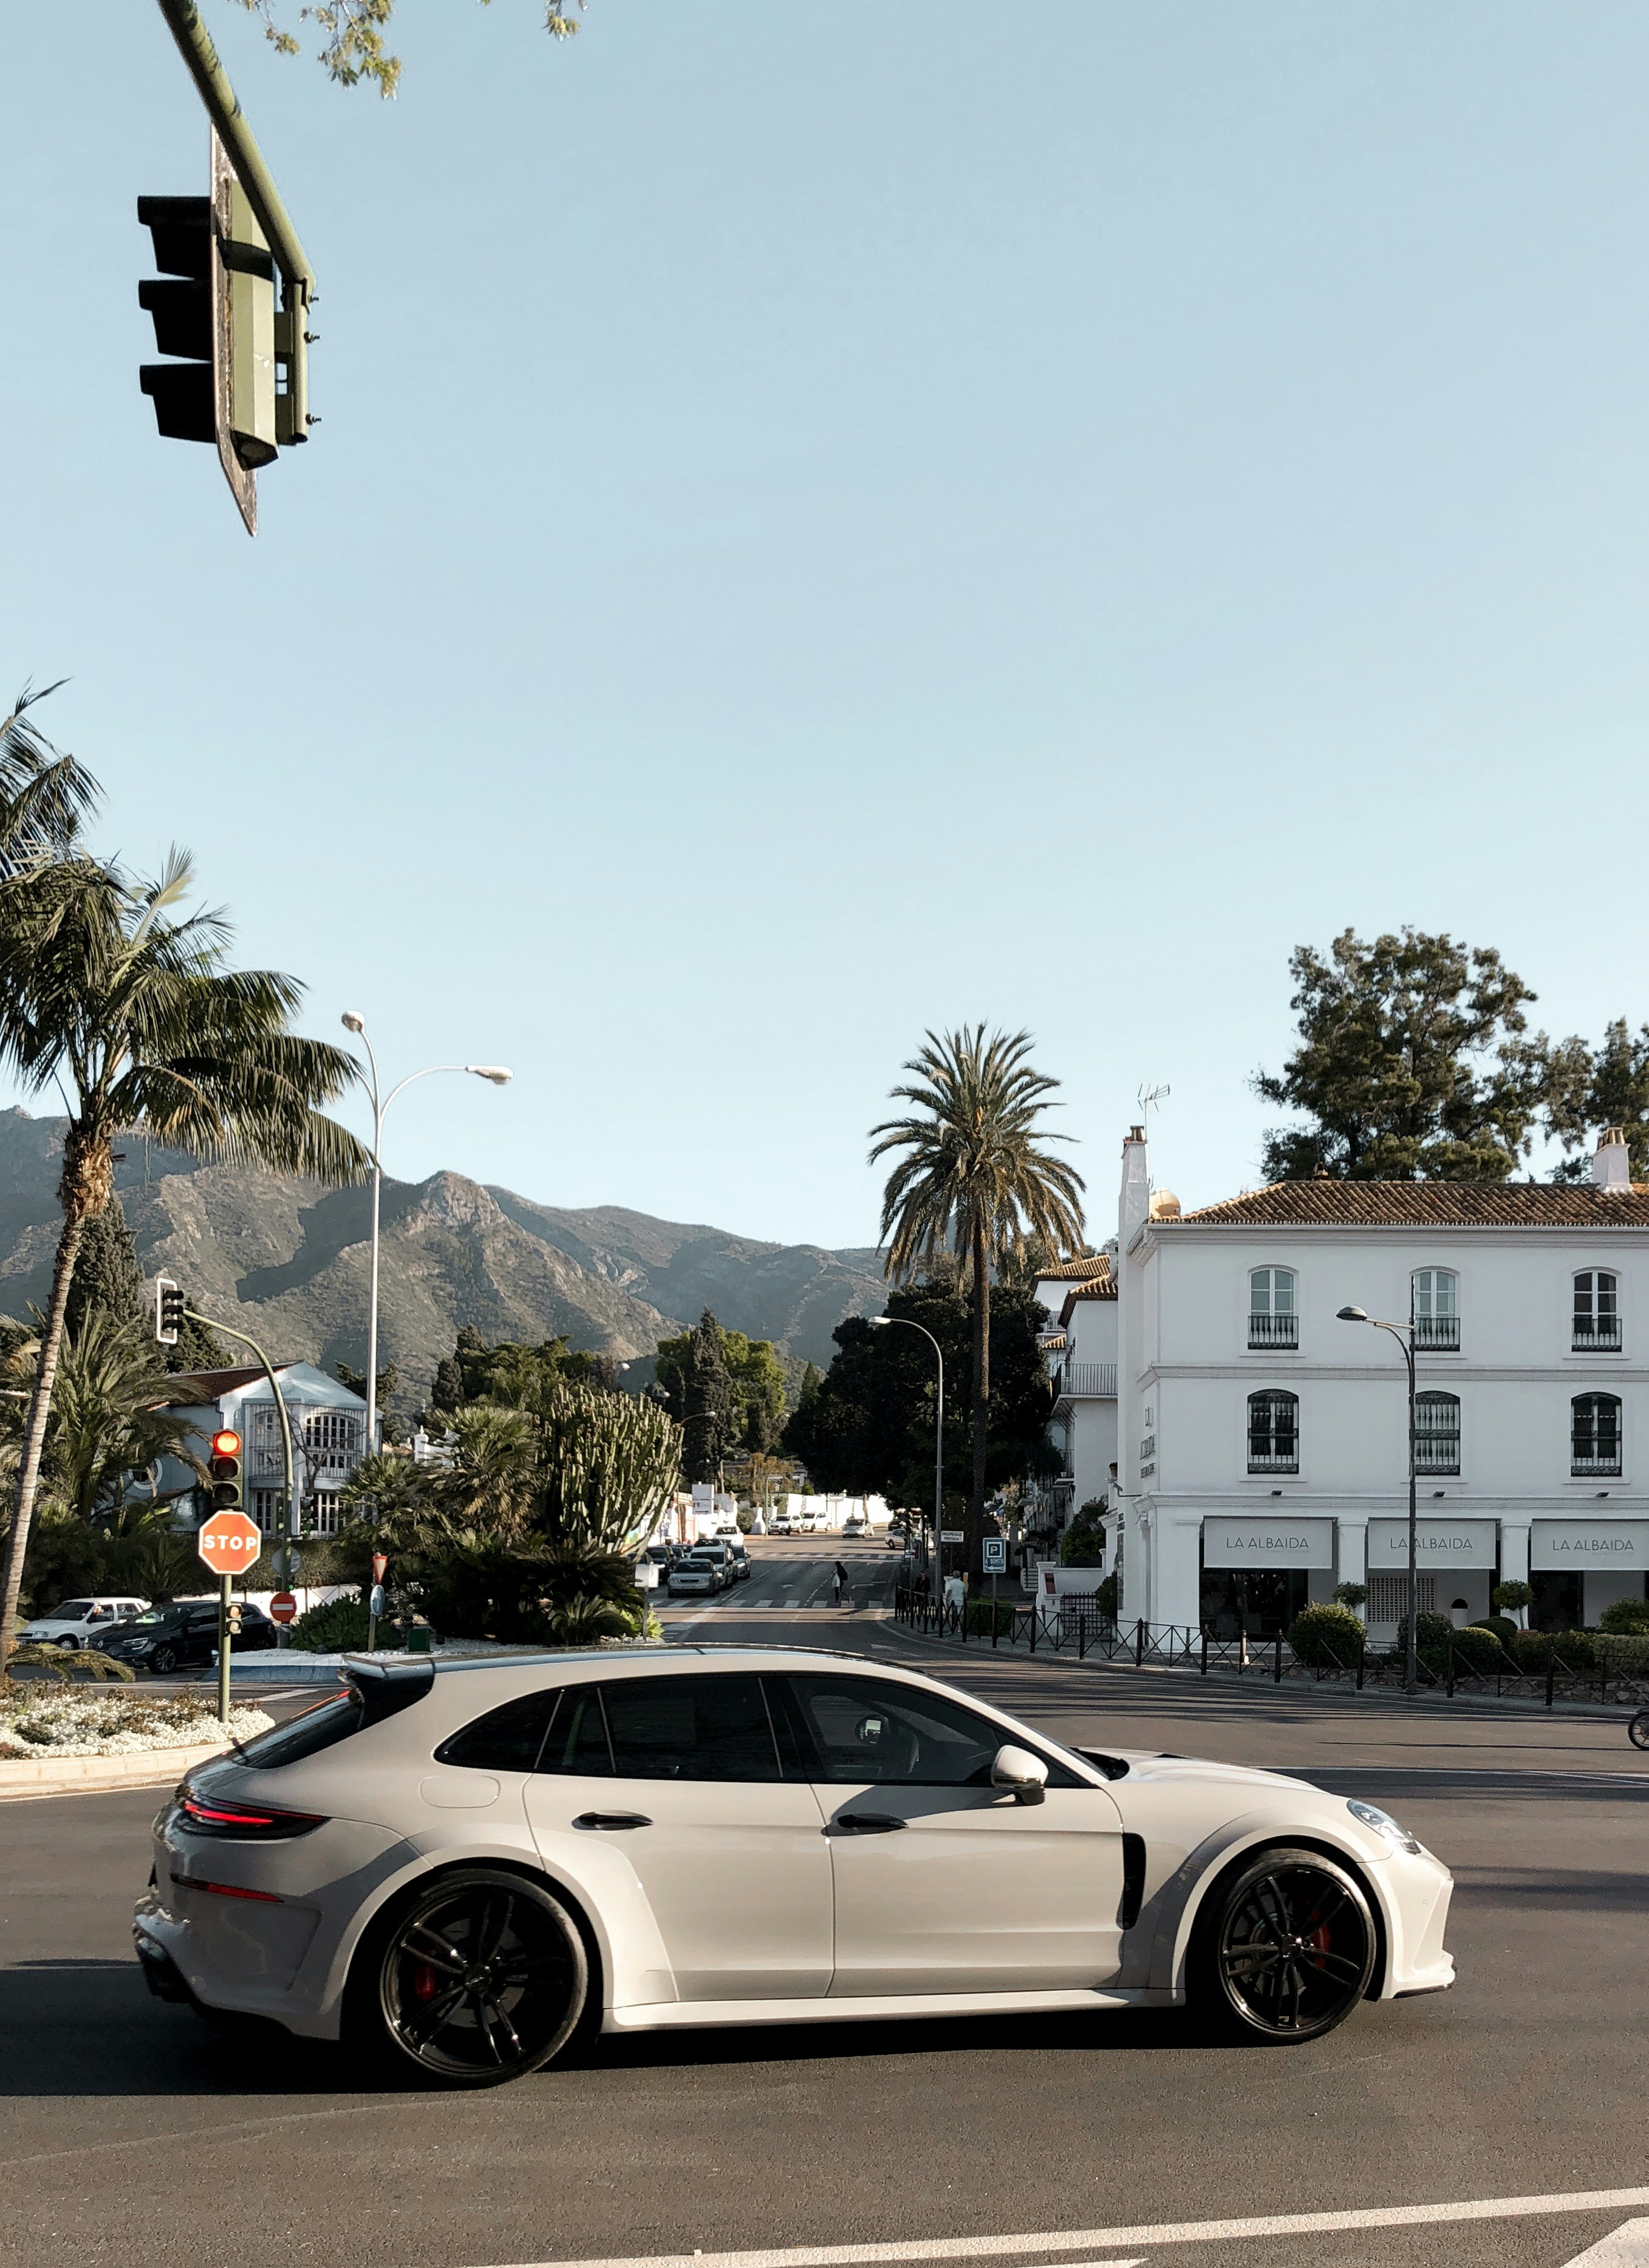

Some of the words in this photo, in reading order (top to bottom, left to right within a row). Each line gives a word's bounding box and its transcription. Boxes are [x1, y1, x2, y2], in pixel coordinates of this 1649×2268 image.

[203, 1534, 257, 1551] STOP
[1226, 1538, 1244, 1548] LA
[1248, 1538, 1309, 1548] ALBAIDA
[1390, 1538, 1408, 1548] LA
[1552, 1539, 1570, 1550] LA
[1574, 1539, 1634, 1550] ALBAIDA
[990, 1545, 998, 1554] P
